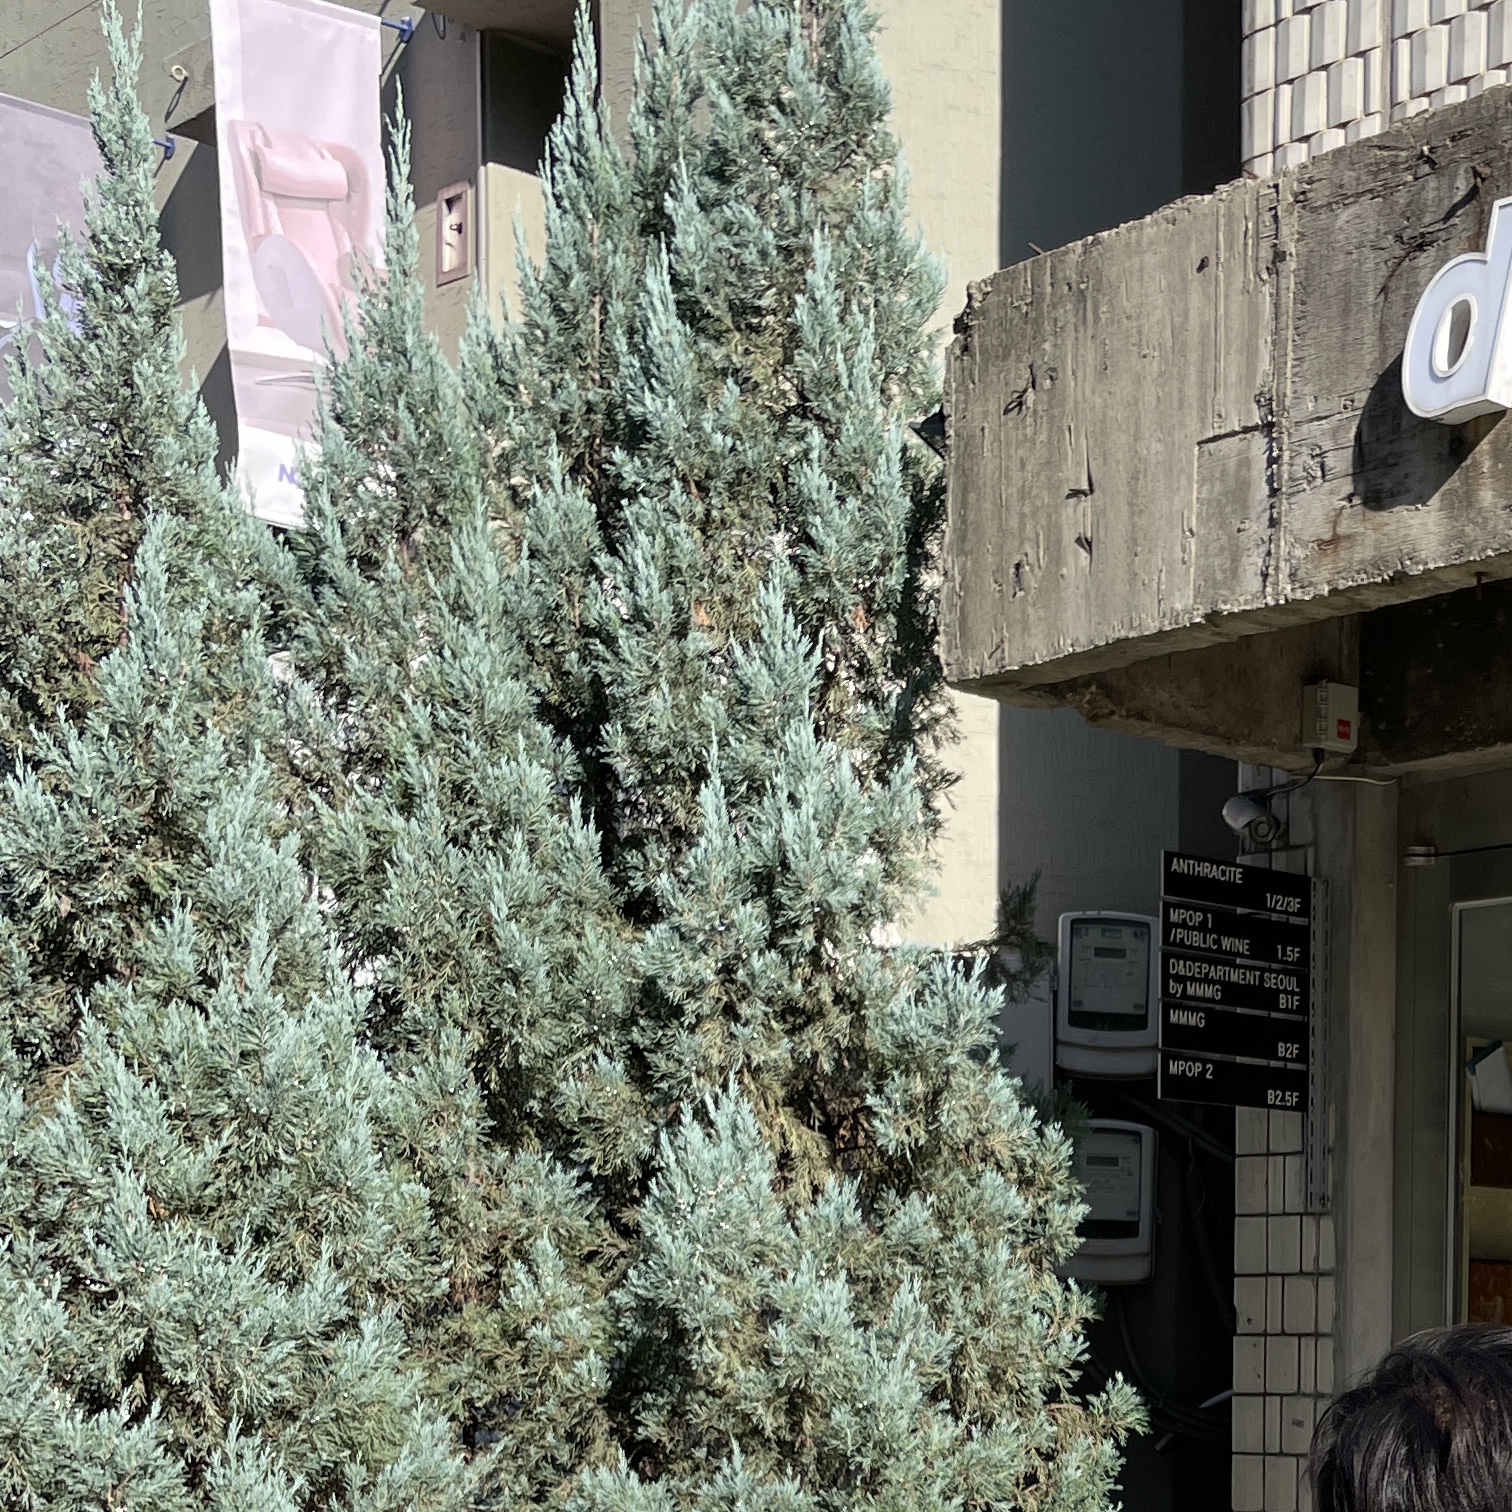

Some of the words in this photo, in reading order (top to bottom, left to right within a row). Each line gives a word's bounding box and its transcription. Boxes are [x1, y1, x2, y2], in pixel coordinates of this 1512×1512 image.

[1171, 857, 1243, 884] ANTHRACITE
[1265, 893, 1301, 913] 1/2/3F
[1169, 907, 1203, 928] MPOP
[1206, 913, 1212, 929] 1
[1169, 928, 1218, 950] /PUBLIC
[1220, 935, 1250, 955] WINE
[1276, 944, 1301, 962] 1.5F
[1169, 958, 1260, 985] D&DEPARTMENT
[1263, 974, 1300, 992] SEOUL
[1169, 979, 1184, 998] by
[1186, 980, 1221, 1000] MMMG
[1279, 993, 1300, 1010] B1F
[1169, 1008, 1205, 1028] MMMG
[1277, 1042, 1300, 1059] B2F
[1169, 1059, 1202, 1078] MPOP
[1205, 1064, 1213, 1079] 2
[1267, 1089, 1299, 1107] B2.5F
